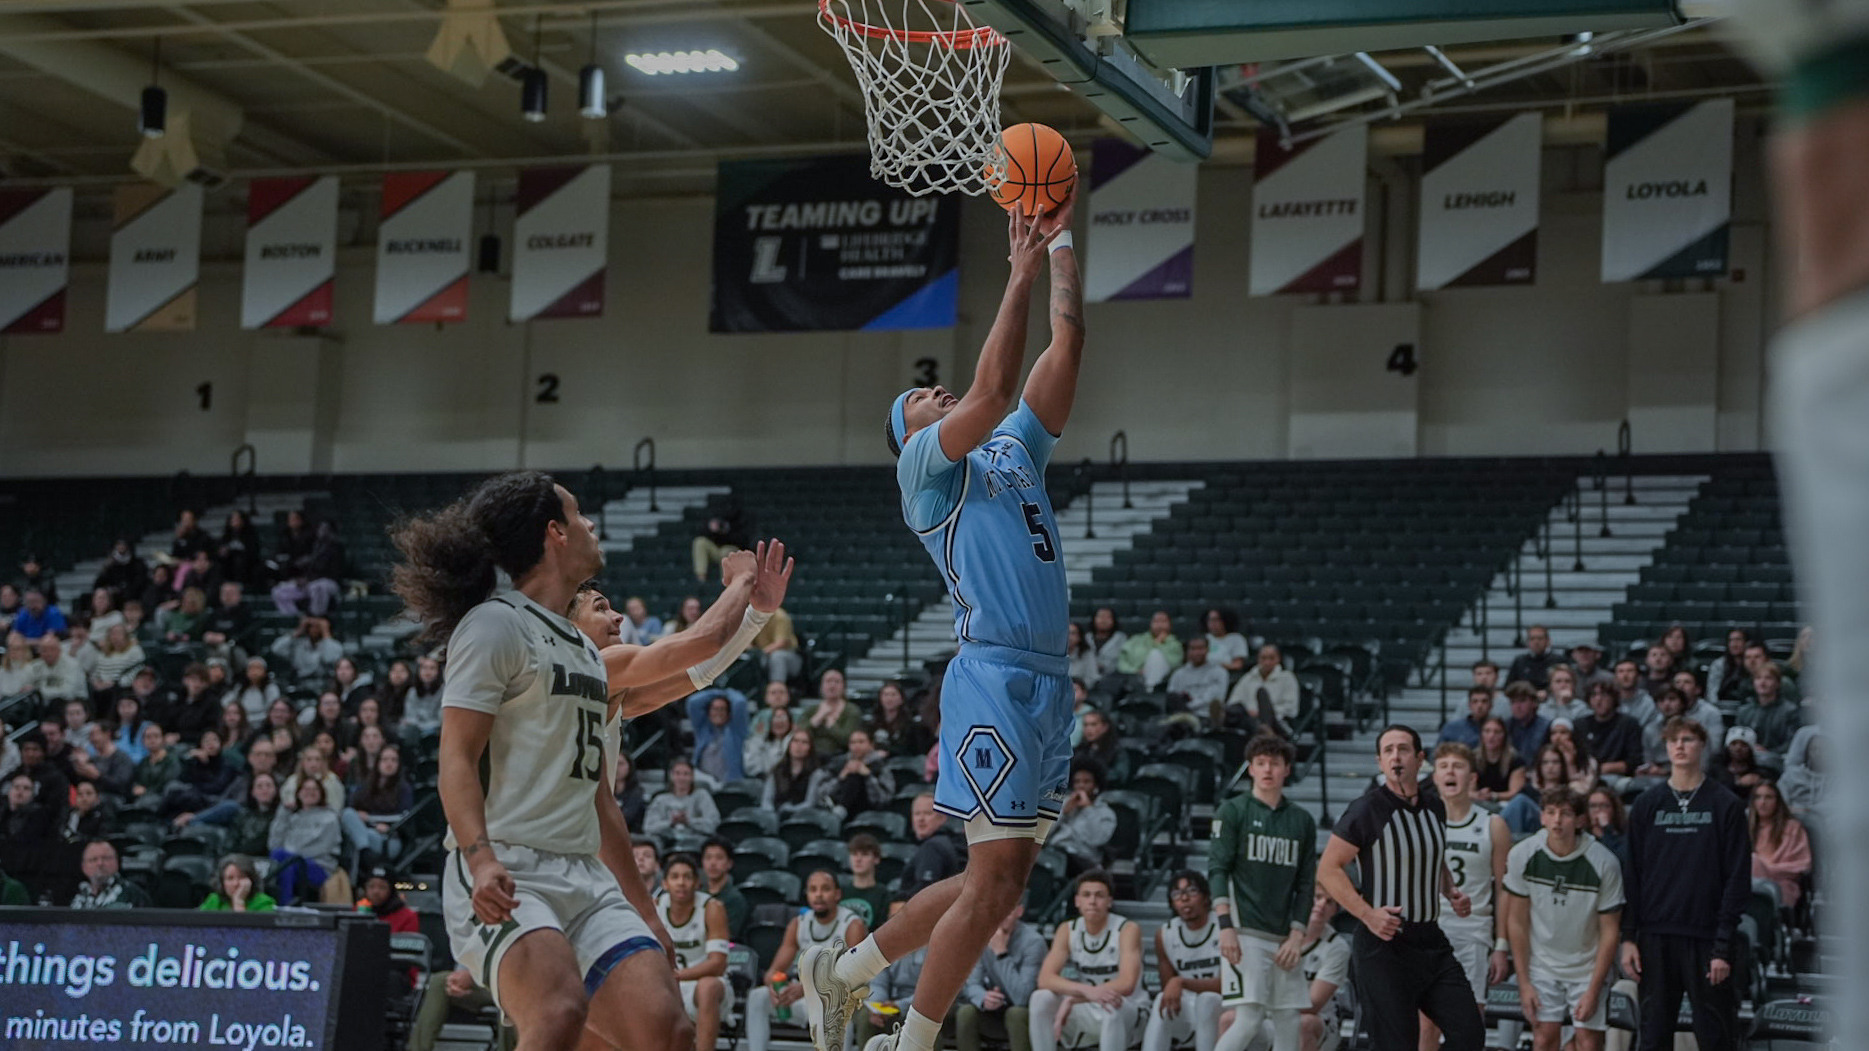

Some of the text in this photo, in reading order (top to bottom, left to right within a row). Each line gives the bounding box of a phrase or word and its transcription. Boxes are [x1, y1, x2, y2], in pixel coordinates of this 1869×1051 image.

[1444, 192, 1516, 210] LEHIGH
[1626, 180, 1708, 200] LOYOLA
[746, 199, 939, 230] TEAMING UP!
[1093, 208, 1192, 225] HOLY CROSS
[1259, 199, 1357, 219] LAFAYETTE
[386, 239, 463, 254] BUCKNELL
[527, 232, 596, 249] COLGATE
[750, 236, 788, 283] L
[914, 357, 939, 389] 3
[1386, 343, 1418, 376] 4
[196, 381, 213, 411] 1
[535, 372, 560, 404] 2
[1020, 501, 1057, 564] 5
[568, 707, 603, 782] 15
[974, 747, 993, 769] M
[1449, 857, 1466, 888] 3
[127, 943, 321, 992] delicious.
[5, 1008, 314, 1051] minutes from Loyola.
